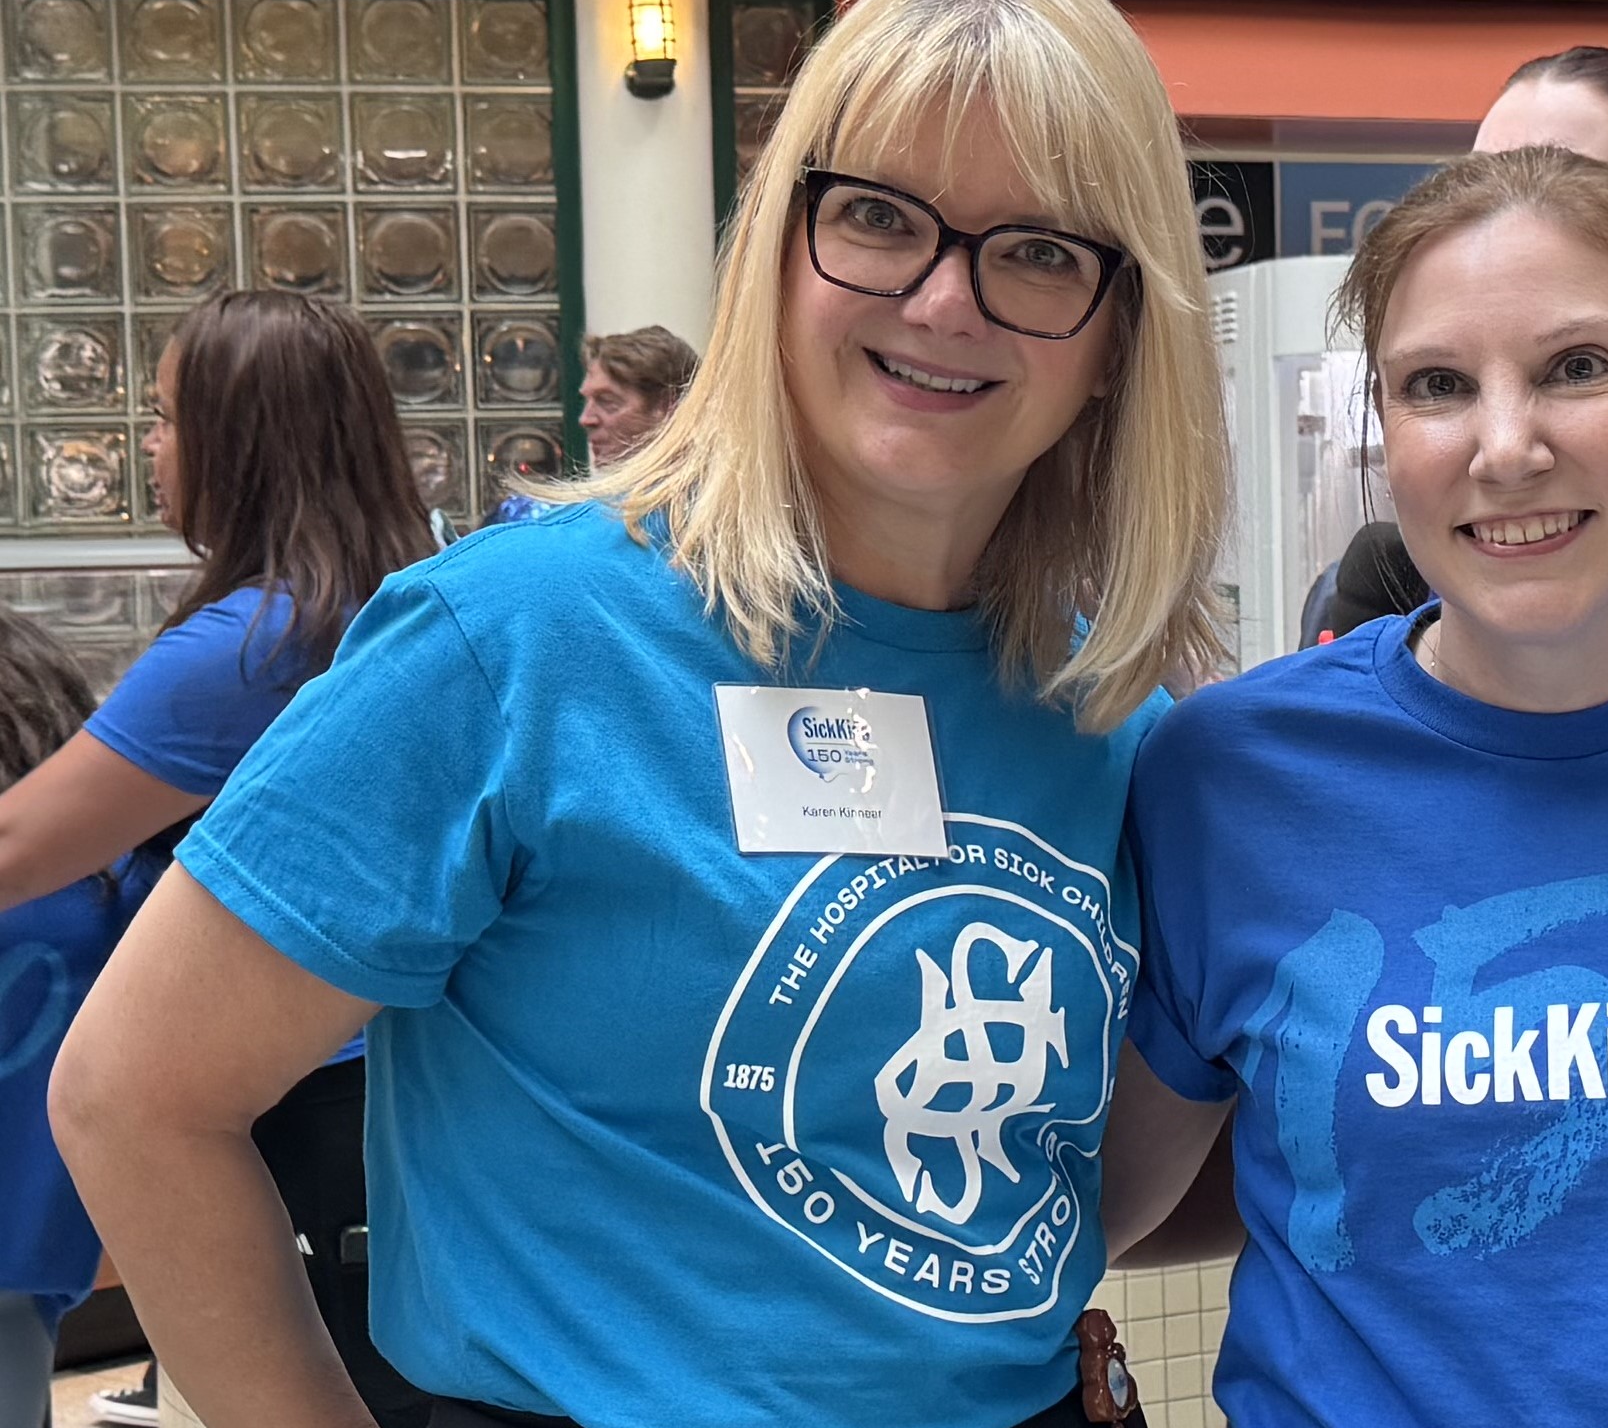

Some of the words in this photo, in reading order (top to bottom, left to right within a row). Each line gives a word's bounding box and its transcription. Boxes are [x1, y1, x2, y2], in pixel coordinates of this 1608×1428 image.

[807, 748, 842, 763] 150
[802, 805, 837, 818] Karen
[769, 943, 820, 1008] THE
[927, 843, 987, 868] OR
[993, 847, 1056, 895] SICK
[1060, 883, 1130, 1021] CHILDREN
[723, 1063, 776, 1093] 1875
[754, 1139, 837, 1226] 150
[856, 1222, 1013, 1296] YEARS
